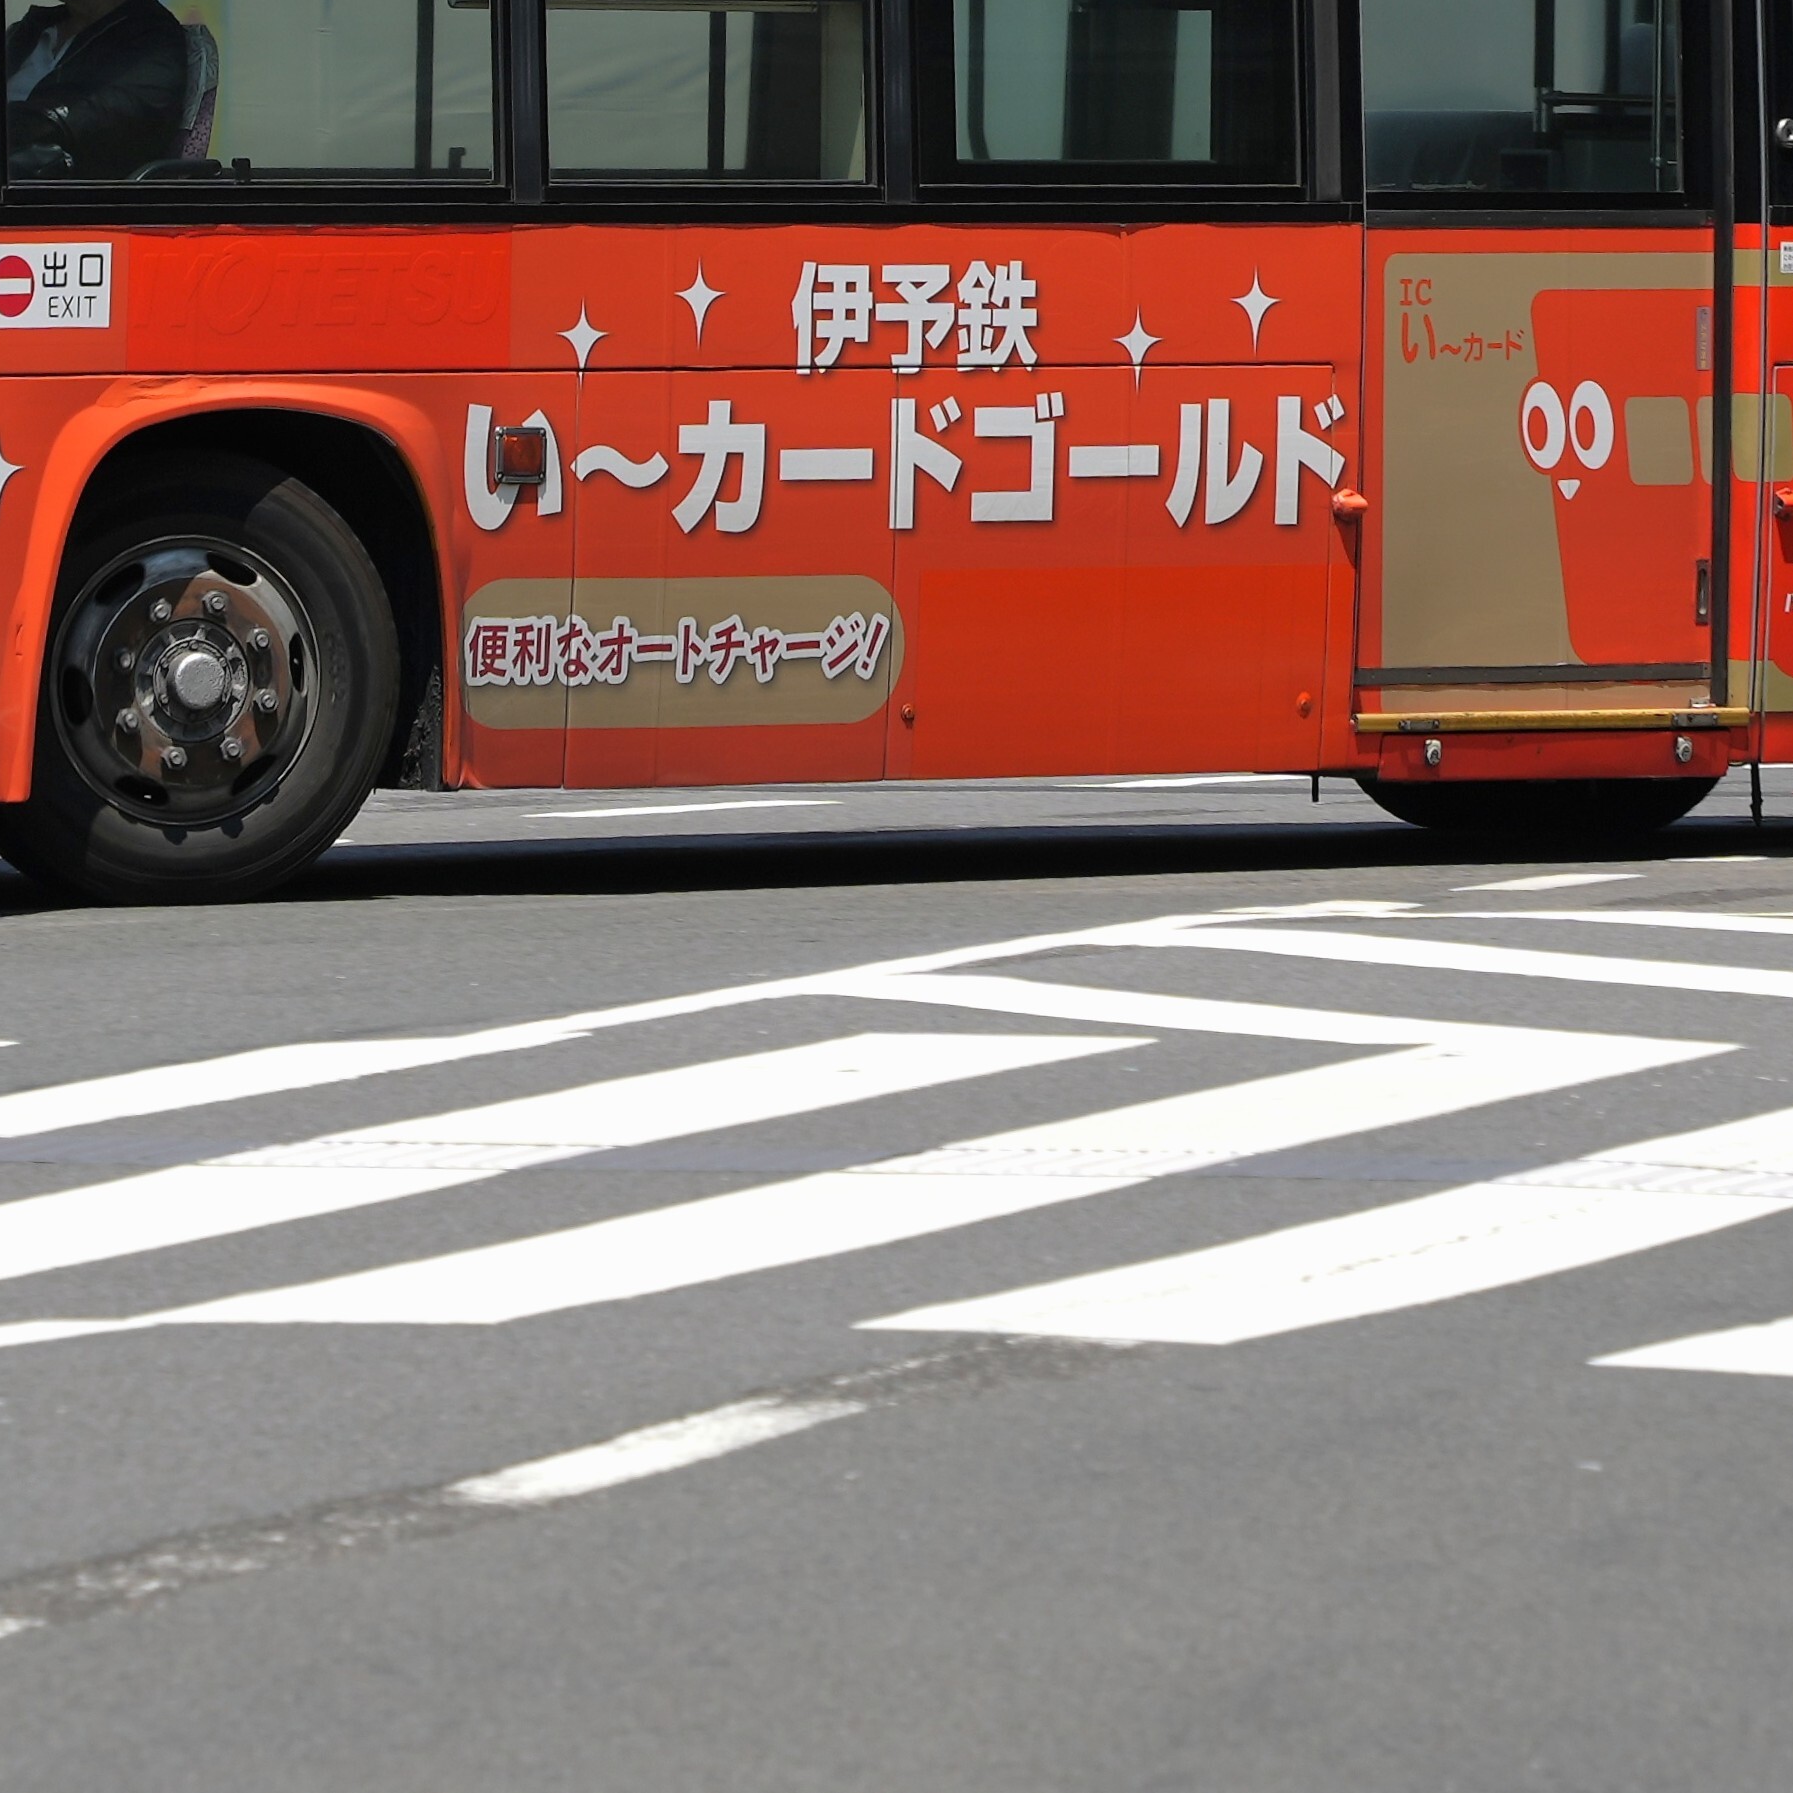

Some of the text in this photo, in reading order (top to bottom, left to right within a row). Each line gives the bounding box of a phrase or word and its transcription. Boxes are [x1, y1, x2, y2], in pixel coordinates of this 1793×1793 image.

[42, 251, 104, 288] 出口
[48, 296, 98, 319] EXIT
[1400, 279, 1432, 306] IC
[791, 259, 1039, 376] 伊予鉄
[464, 610, 891, 686] 便利なオートチャージ！
